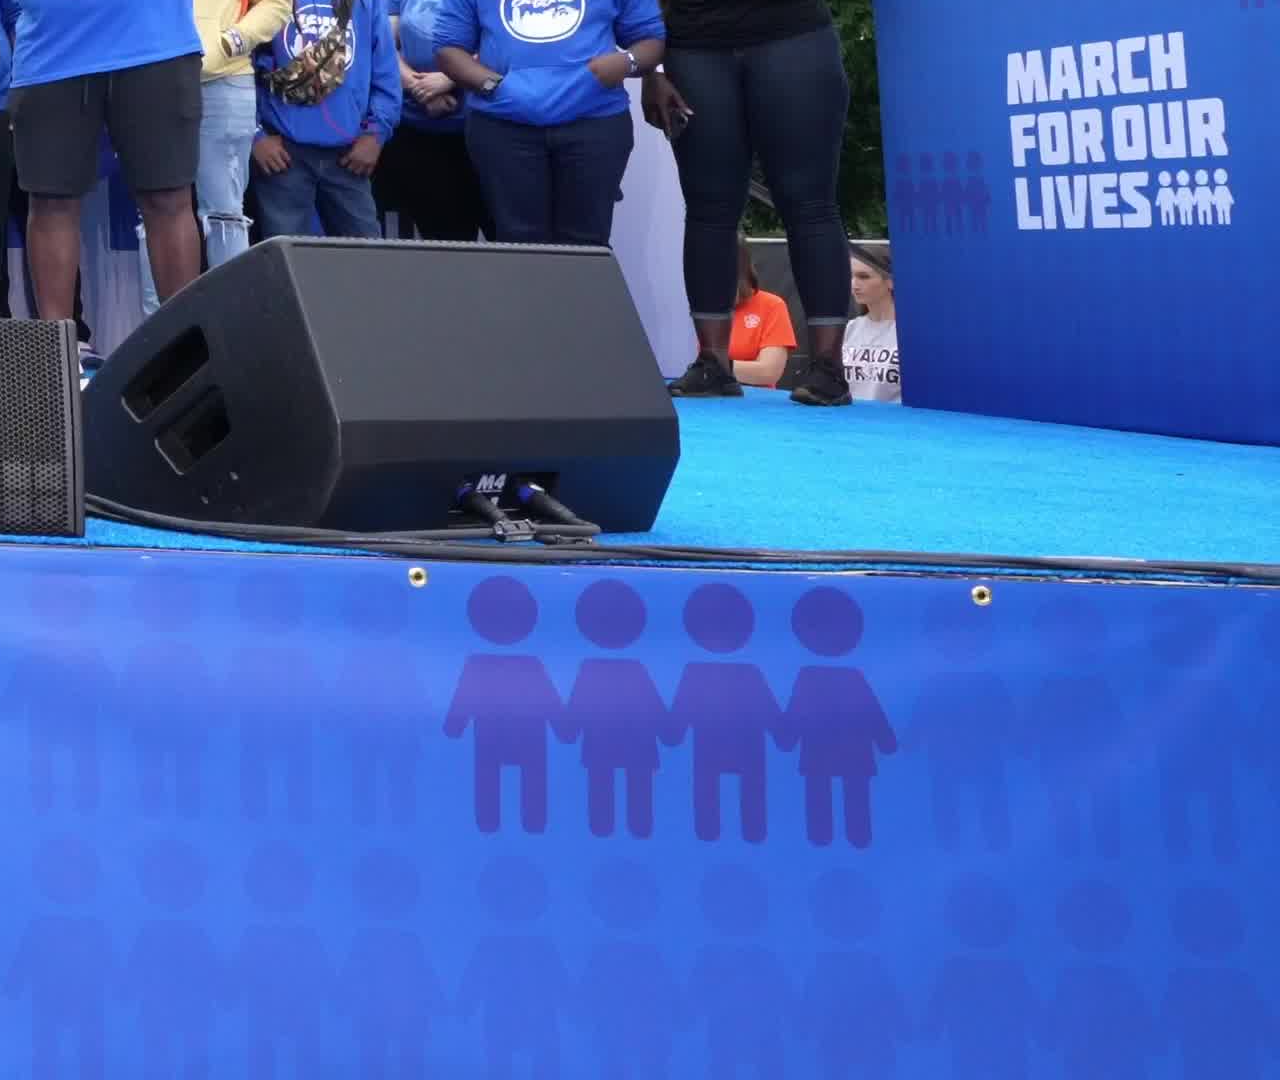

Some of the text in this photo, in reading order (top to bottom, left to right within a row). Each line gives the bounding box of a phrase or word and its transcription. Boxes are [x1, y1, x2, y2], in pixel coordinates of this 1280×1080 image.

[1006, 31, 1188, 106] MARCH
[1010, 97, 1228, 168] FOR OUR
[1014, 171, 1152, 231] LIVES
[843, 366, 899, 384] TRNG
[476, 473, 507, 491] M4
